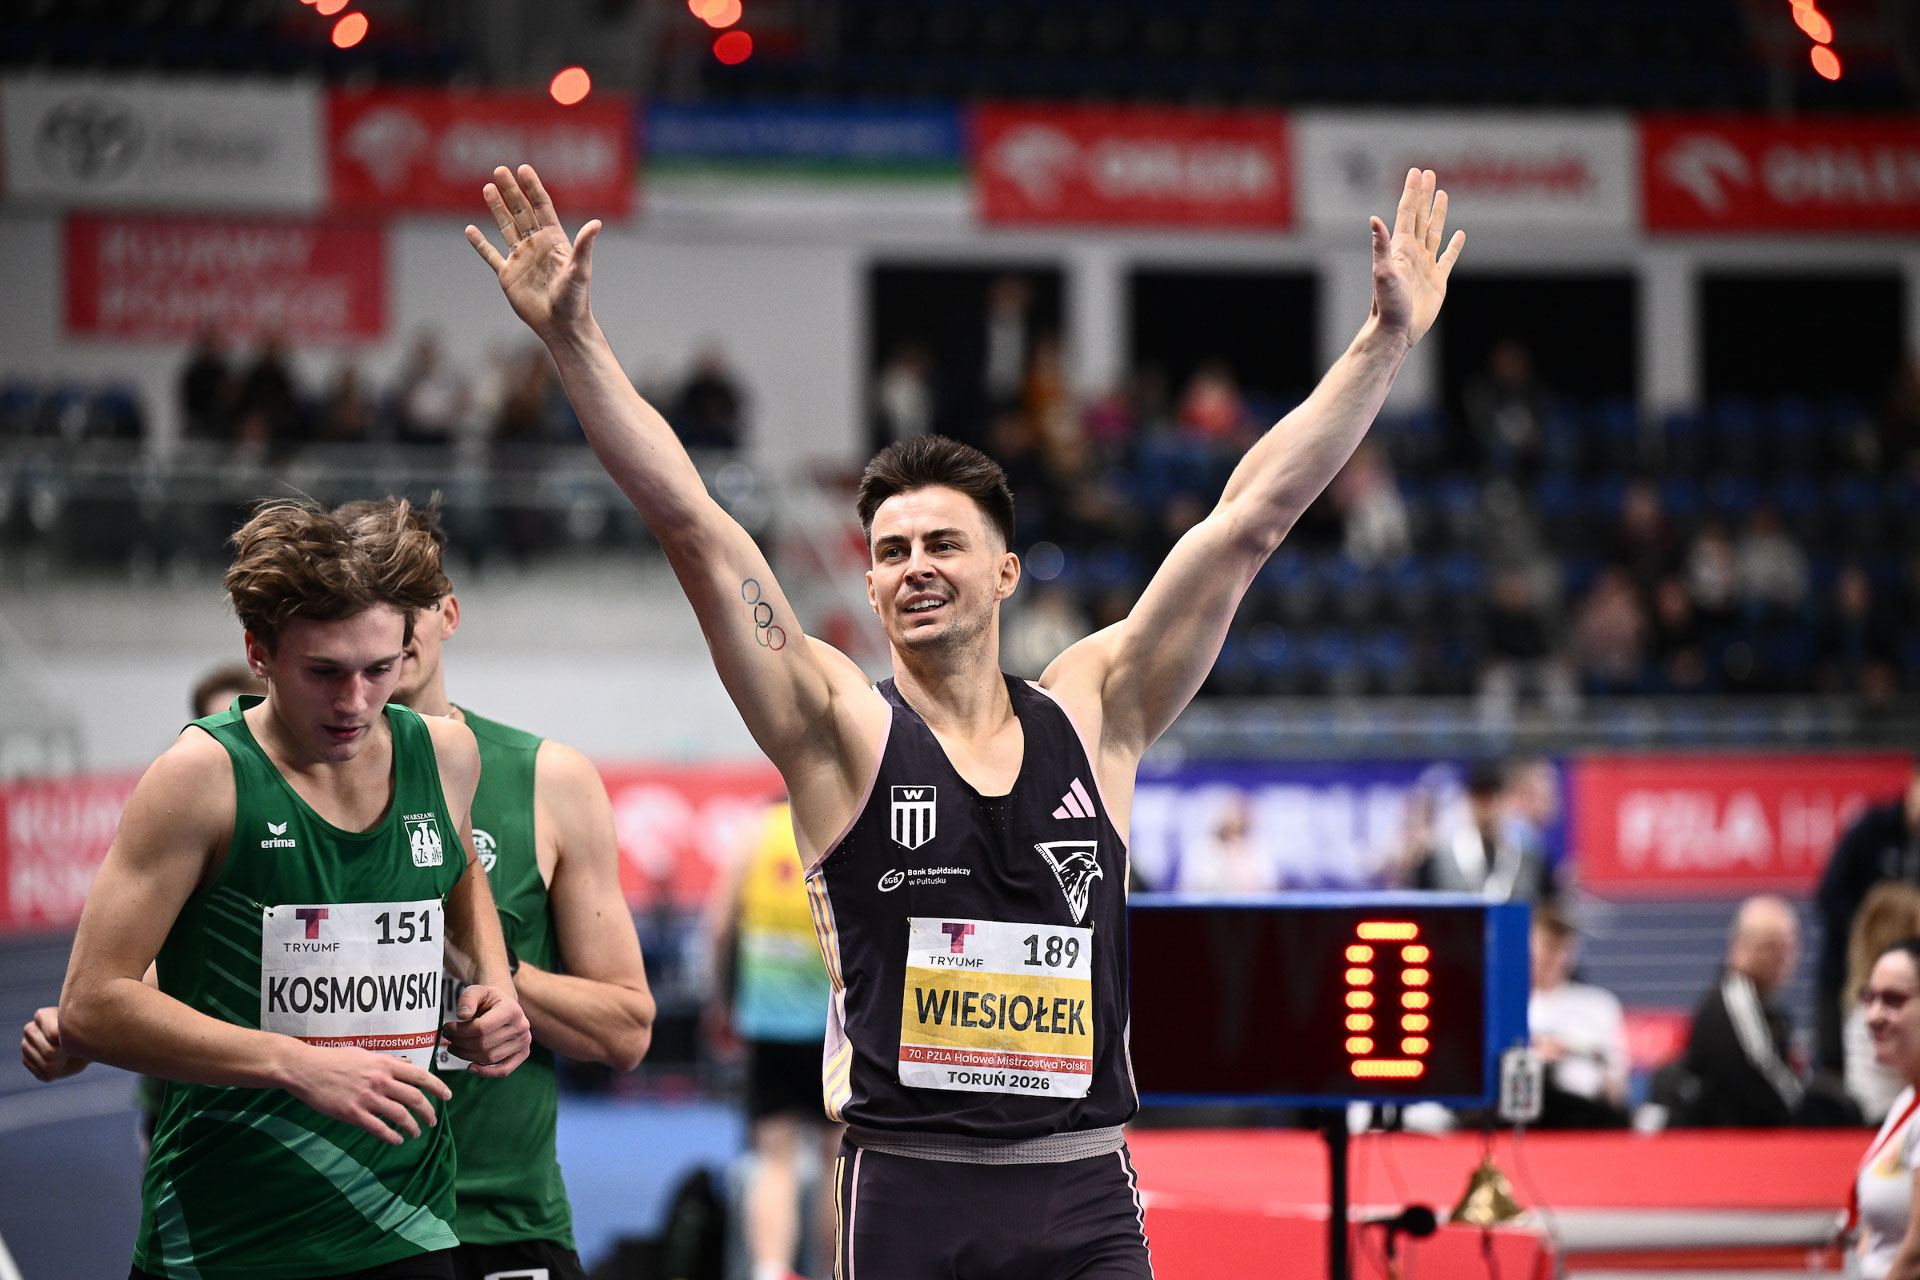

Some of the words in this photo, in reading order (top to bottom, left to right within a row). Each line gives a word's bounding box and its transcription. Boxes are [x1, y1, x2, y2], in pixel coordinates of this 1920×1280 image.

[903, 789, 925, 800] W
[261, 837, 296, 848] erima
[907, 867, 927, 876] Bank
[927, 866, 971, 876] Spółdzielczy
[884, 876, 899, 885] SGB
[374, 910, 432, 945] 151
[283, 942, 340, 953] TRYUMF
[1023, 934, 1080, 969] 189
[929, 955, 984, 968] TRYUMF
[268, 971, 437, 1014] KOSMOWSKI
[1345, 921, 1430, 1078] 0
[914, 987, 1086, 1036] WIESIOŁEK
[356, 1037, 415, 1049] Mistrzostwa
[416, 1034, 435, 1046] Polski
[908, 1048, 924, 1060] 70.
[926, 1049, 952, 1062] PZLA
[954, 1051, 995, 1065] Halowe
[996, 1054, 1059, 1071] Mistrzostwa
[1060, 1059, 1087, 1072] Polski
[947, 1070, 1006, 1087] TORUŃ
[1009, 1075, 1050, 1090] 2026
